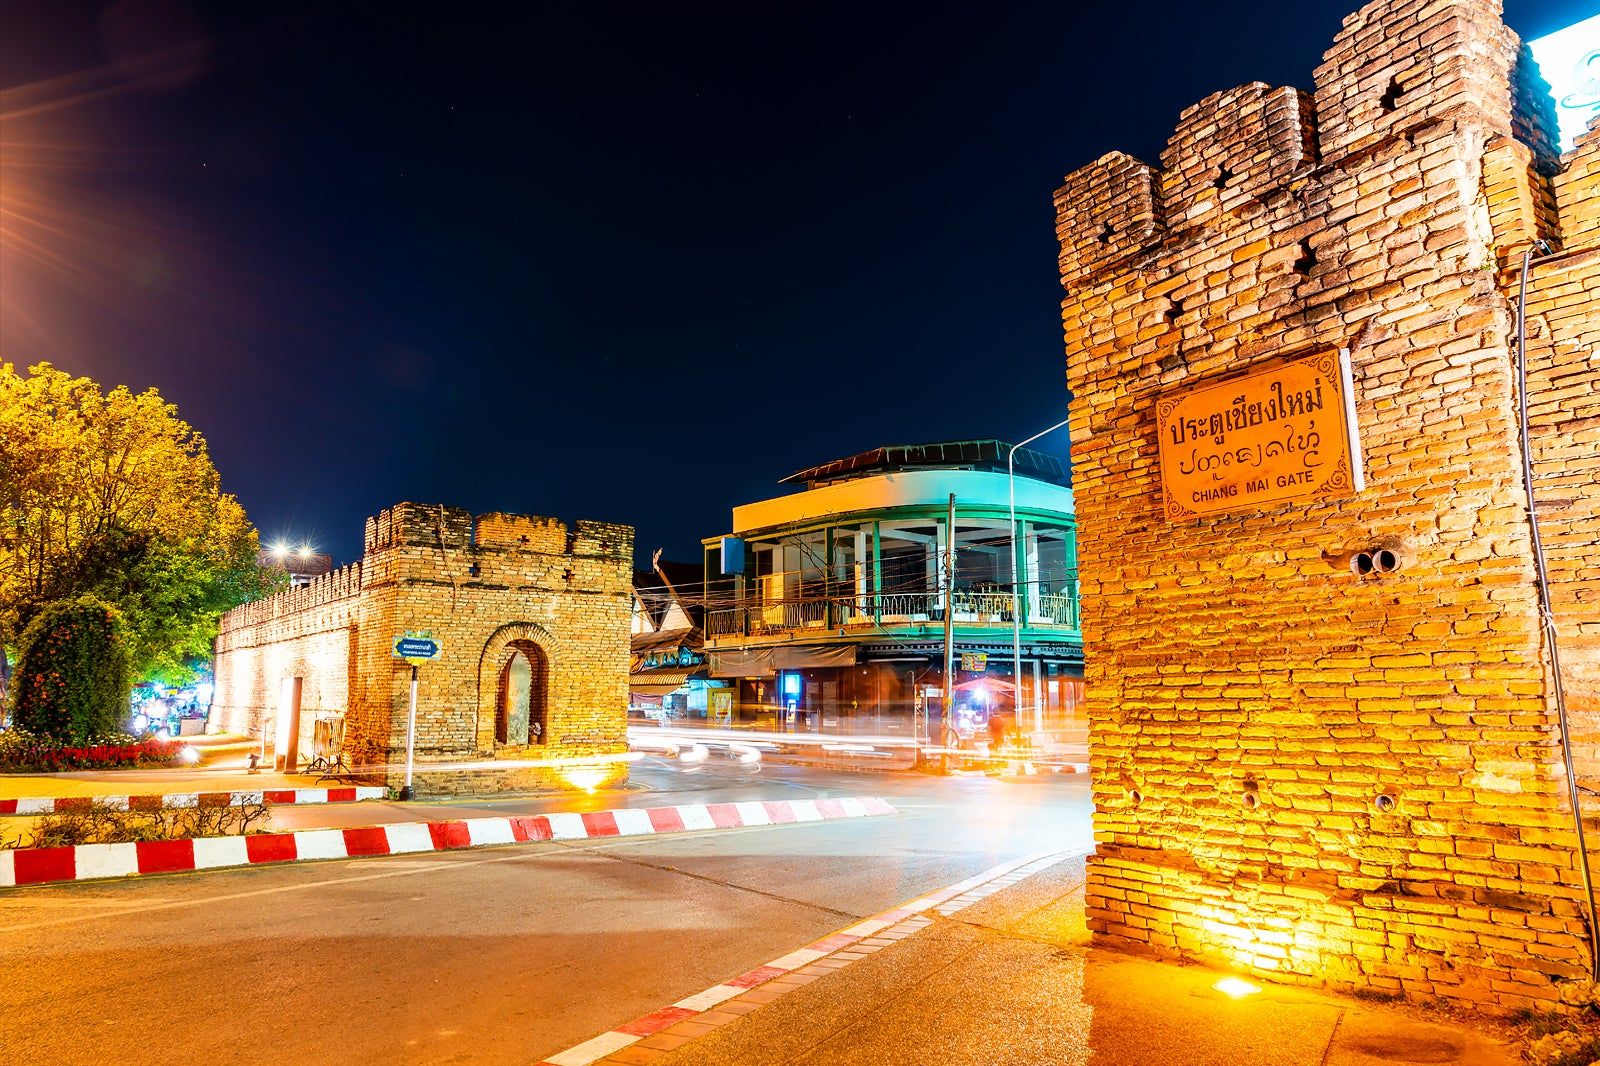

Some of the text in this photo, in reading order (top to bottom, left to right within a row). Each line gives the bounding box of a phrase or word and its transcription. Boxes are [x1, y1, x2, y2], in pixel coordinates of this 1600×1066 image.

[1171, 378, 1323, 445] ประตูเชียงใหม่
[1192, 470, 1314, 503] CHIANG MAI GATE
